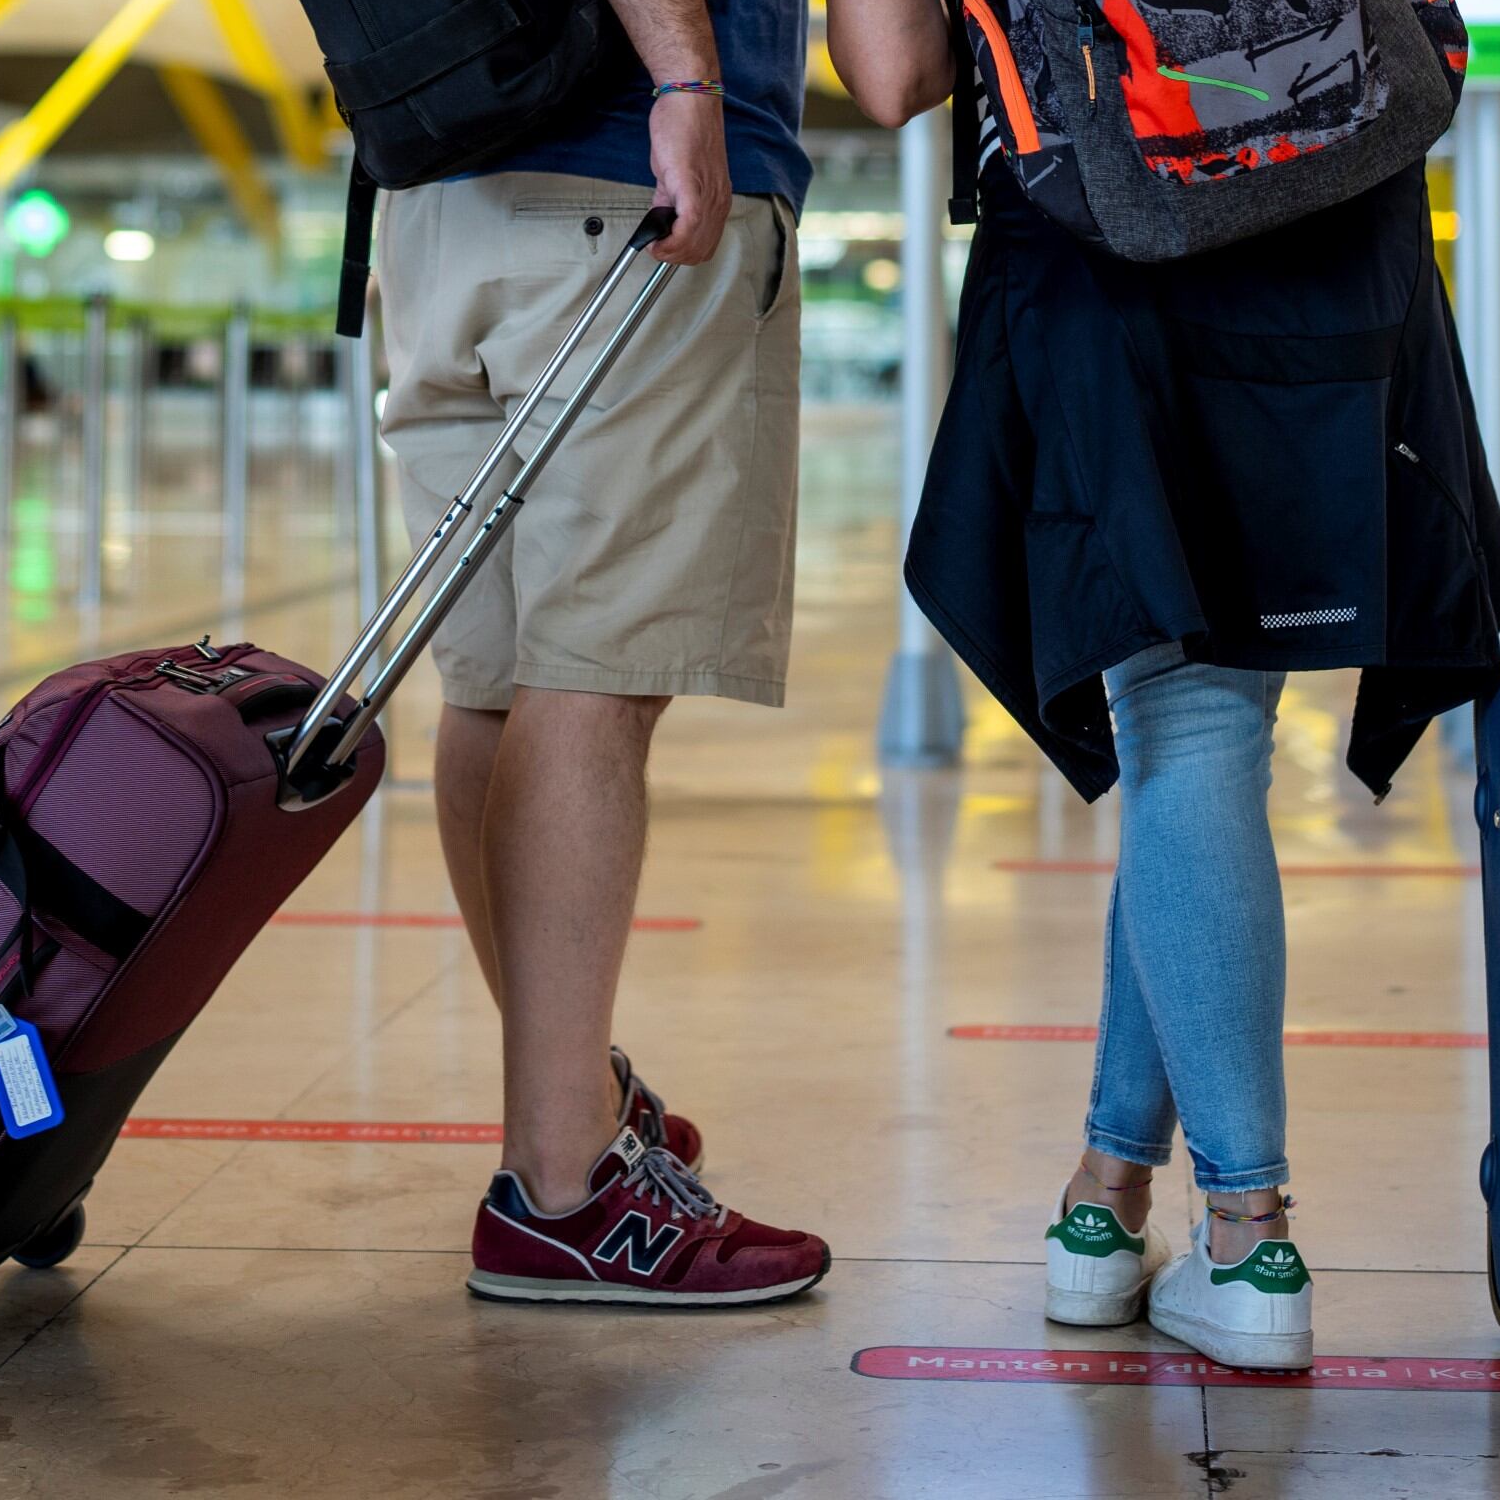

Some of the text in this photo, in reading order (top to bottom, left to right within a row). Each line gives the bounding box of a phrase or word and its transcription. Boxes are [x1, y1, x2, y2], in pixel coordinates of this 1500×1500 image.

[1066, 1224, 1113, 1243] stan smith
[592, 1210, 664, 1276] N
[1254, 1263, 1276, 1278] stan
[907, 1356, 1089, 1372] Mantén
[1108, 1359, 1148, 1374] la
